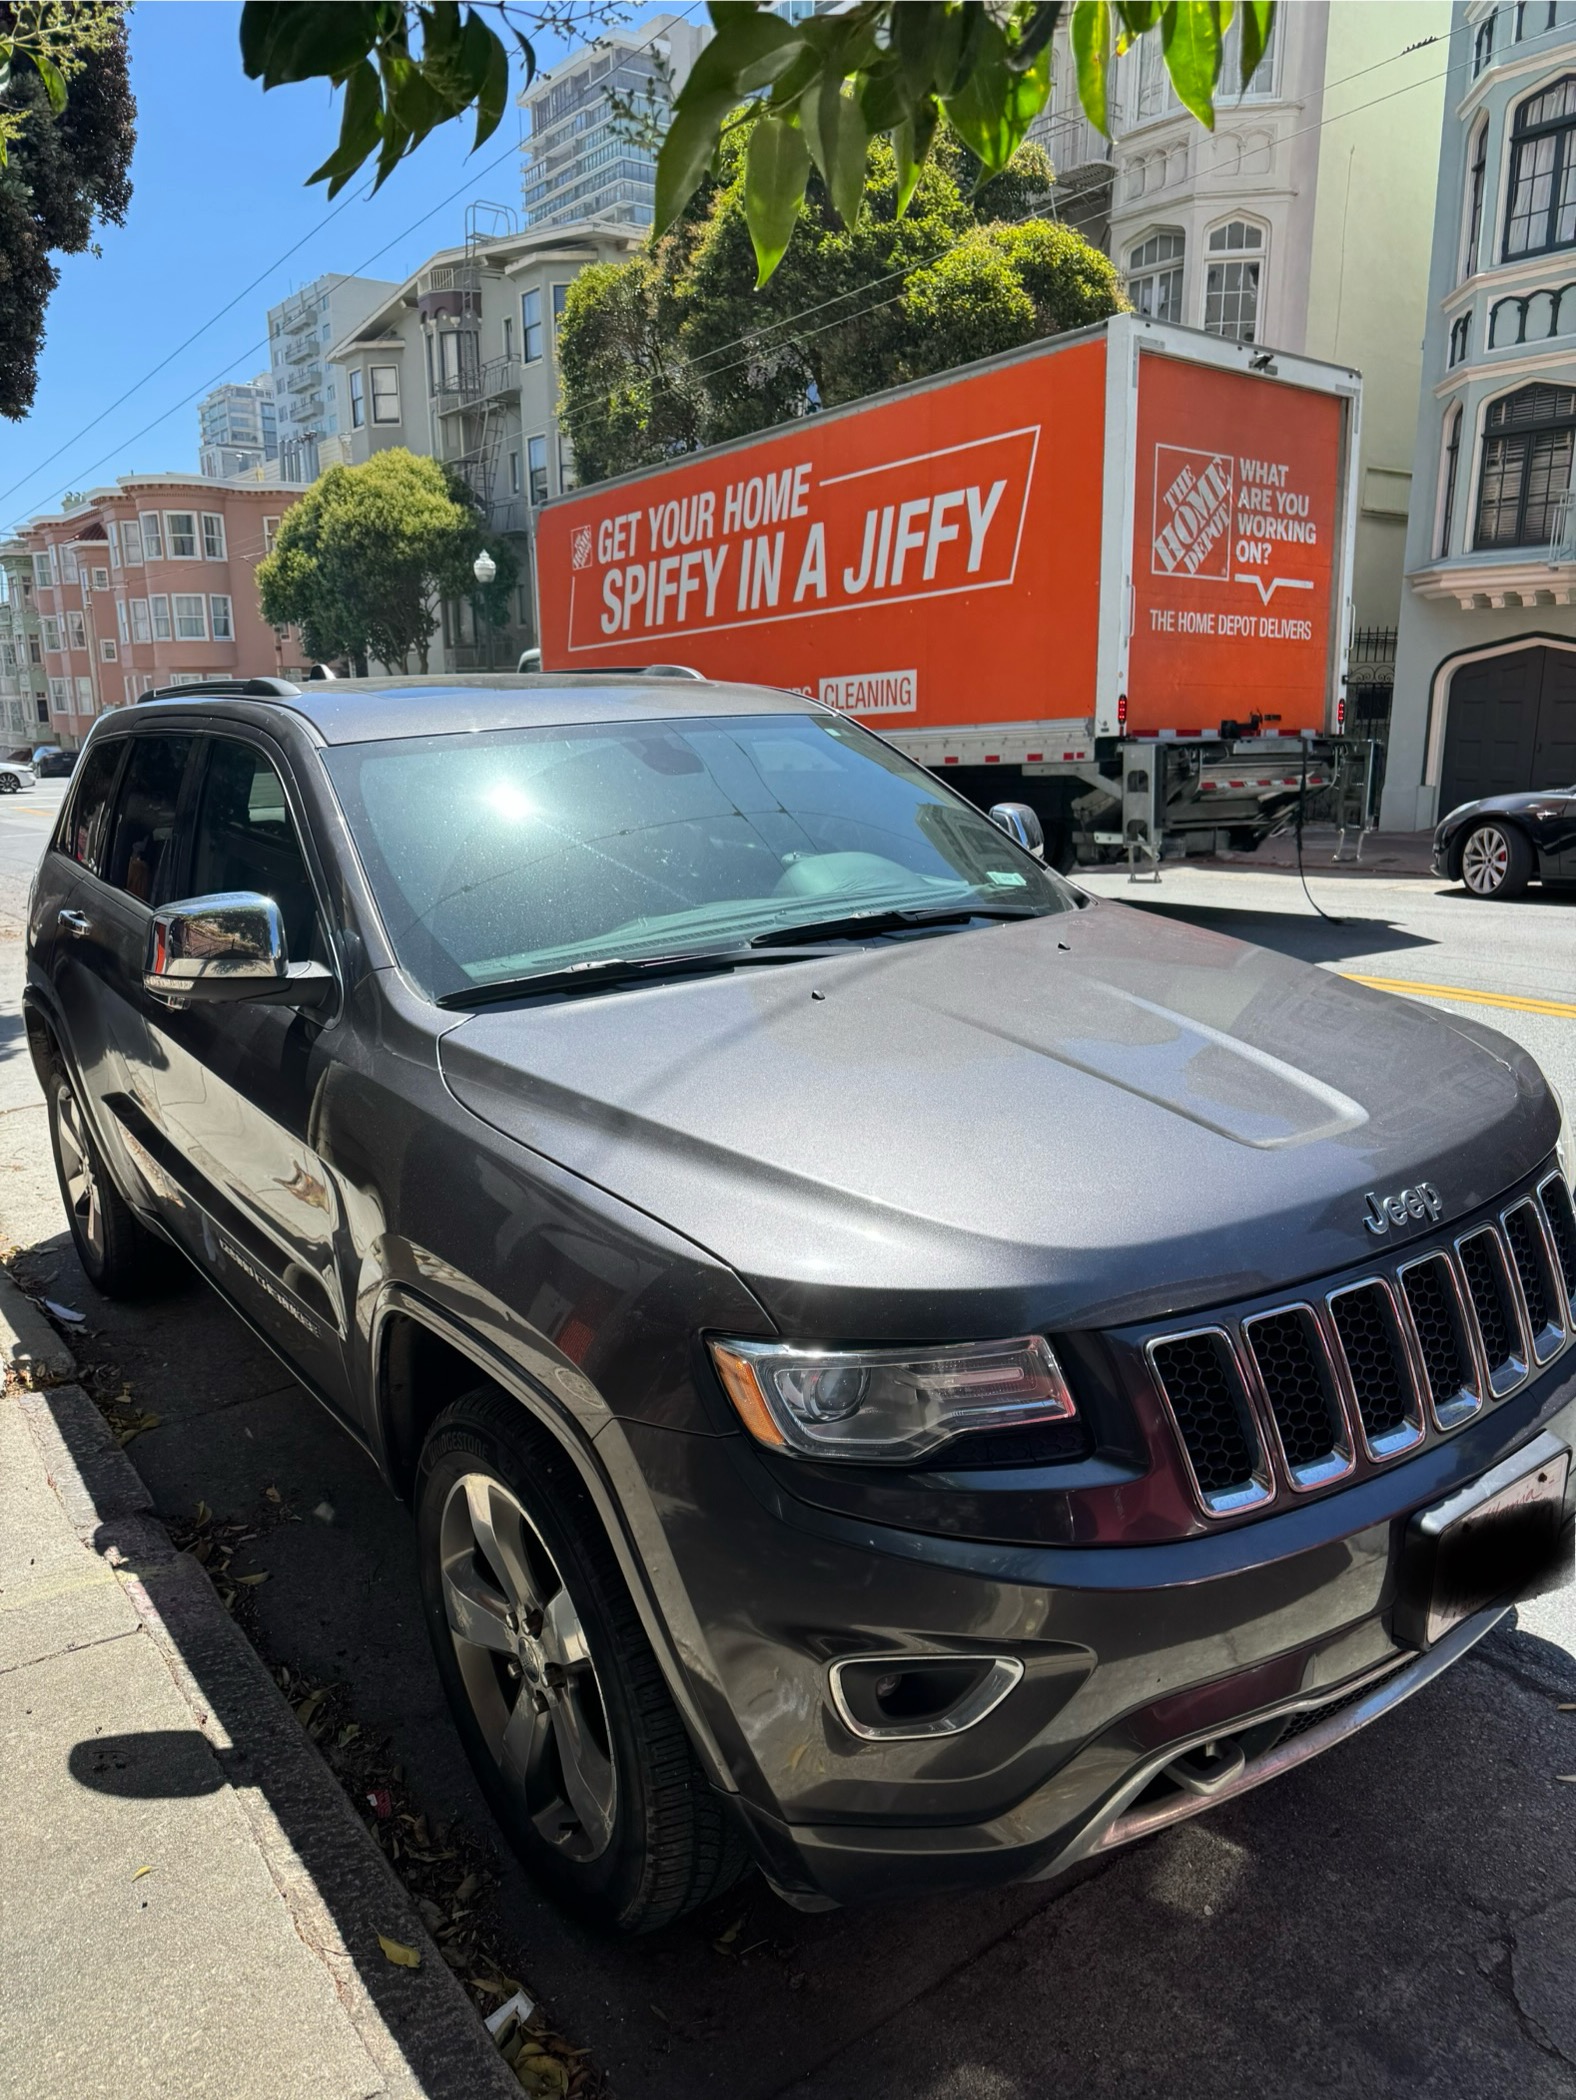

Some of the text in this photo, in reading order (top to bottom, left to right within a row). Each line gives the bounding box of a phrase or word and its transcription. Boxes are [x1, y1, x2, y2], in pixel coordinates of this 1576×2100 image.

[1163, 464, 1196, 512] THE
[1239, 457, 1289, 488] WHAT
[598, 462, 813, 564] GET YOUR HOME
[1154, 456, 1231, 574] HOME
[1238, 485, 1309, 517] ARE YOU
[1184, 502, 1229, 575] DEPOT
[1238, 512, 1316, 545] WORKING
[601, 480, 1008, 634] SPIFFY IN A JIFFY
[1236, 539, 1272, 565] ON?
[1150, 609, 1312, 641] THE HOME DEPOT DELIVERS
[824, 677, 911, 710] CLEANING
[1362, 1182, 1442, 1235] Jeep
